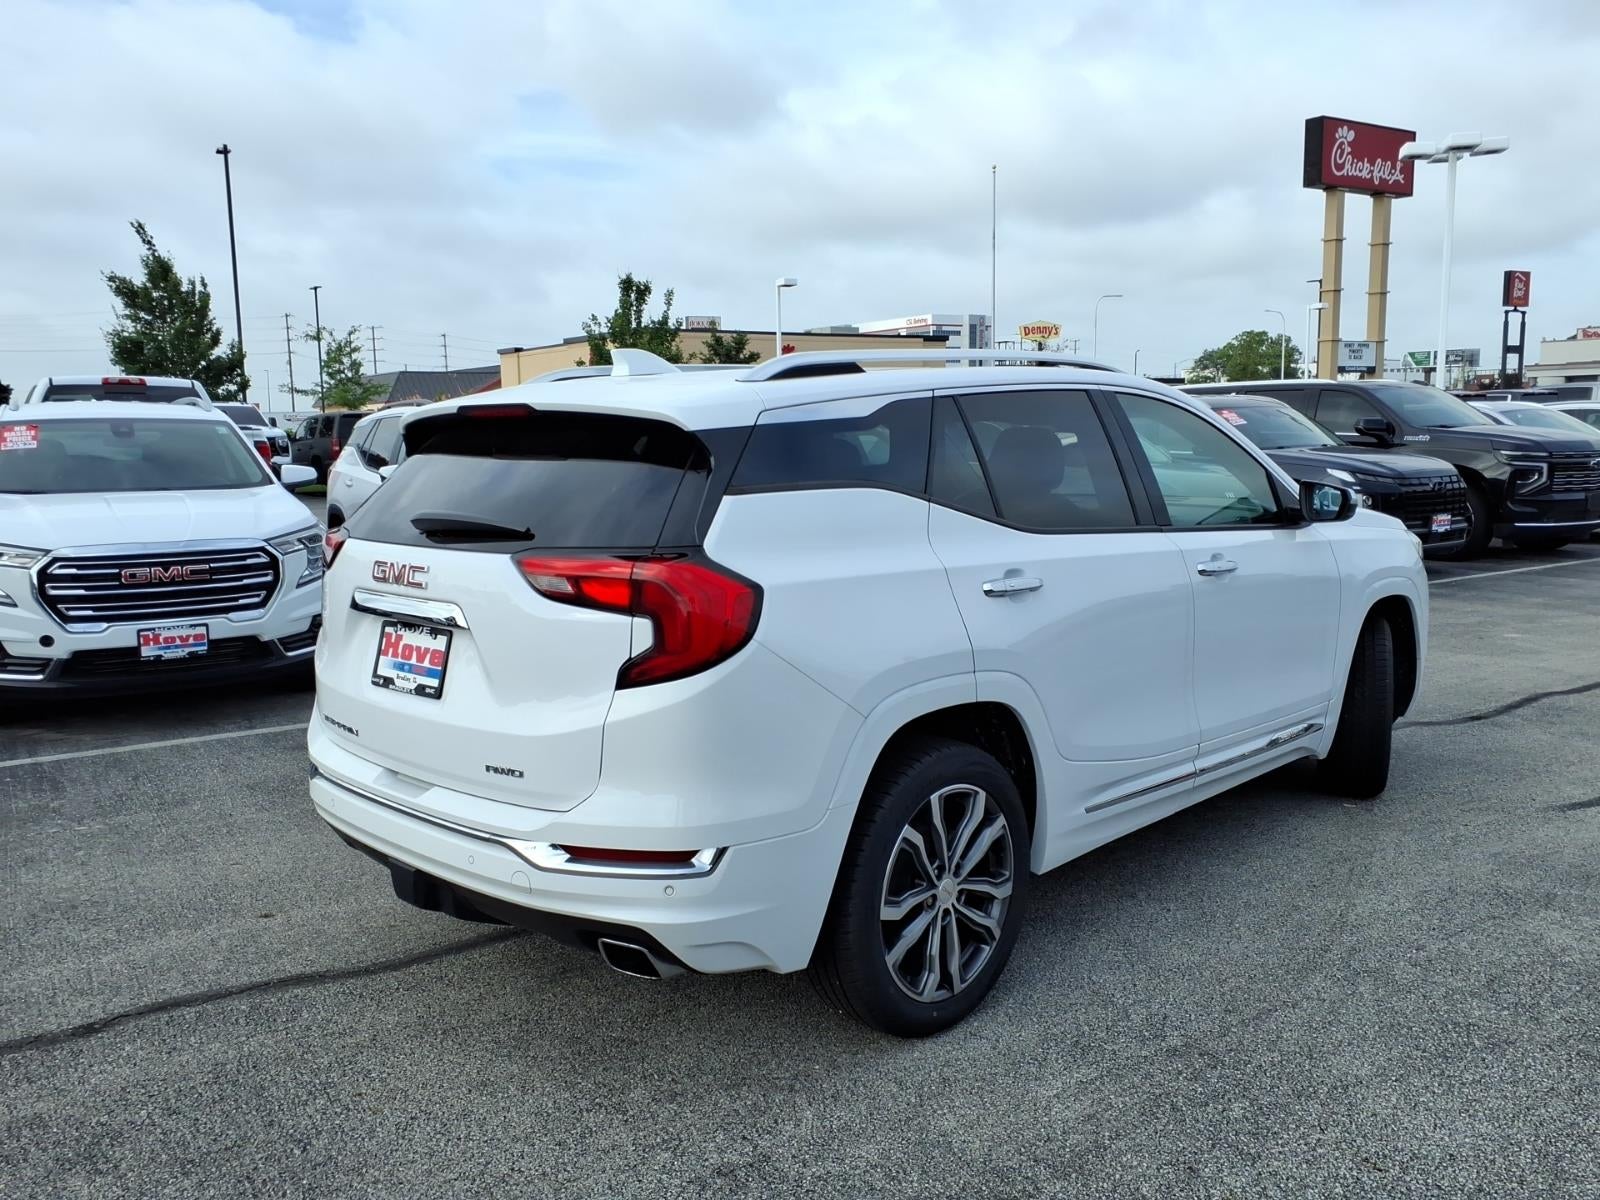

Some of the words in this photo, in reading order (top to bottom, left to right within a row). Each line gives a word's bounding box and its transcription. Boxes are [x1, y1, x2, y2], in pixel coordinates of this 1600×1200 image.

[1331, 126, 1405, 185] Chick-fil-A
[1023, 325, 1060, 338] Denny's
[121, 565, 210, 584] GMC
[372, 560, 429, 589] GMC
[141, 633, 206, 646] Hove
[381, 632, 445, 667] Hove
